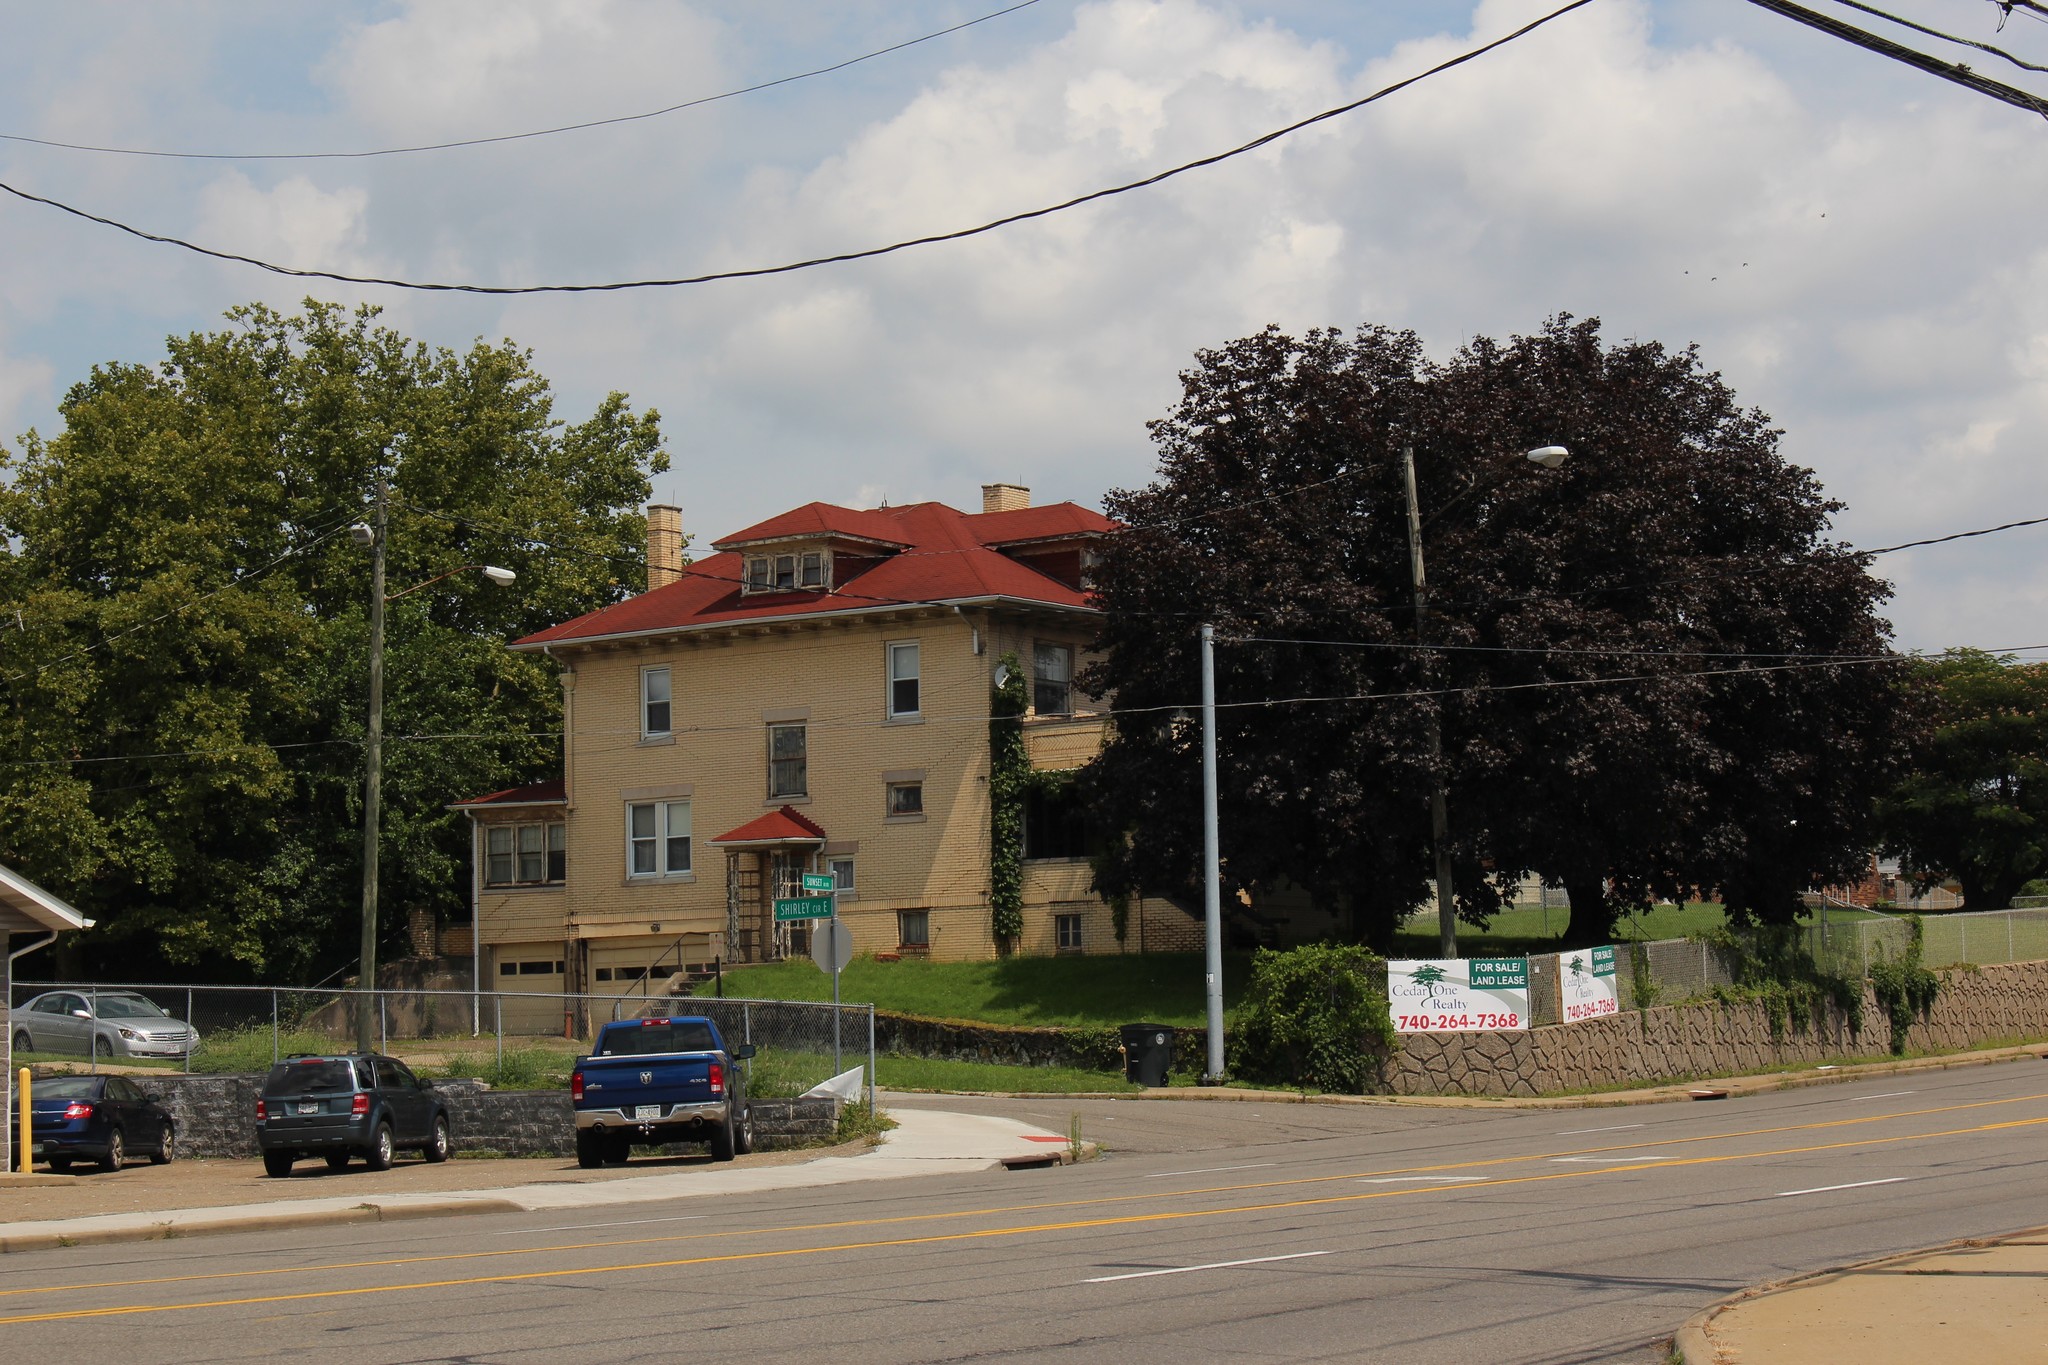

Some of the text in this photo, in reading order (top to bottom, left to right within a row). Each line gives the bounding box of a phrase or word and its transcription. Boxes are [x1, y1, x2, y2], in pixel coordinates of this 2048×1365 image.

[807, 878, 822, 887] SUNSET
[781, 901, 828, 915] SHIRLEY CIR E
[1475, 962, 1520, 972] FOR SALE/
[1593, 962, 1615, 974] LAND LEASE
[1471, 975, 1525, 985] LAND LEASE
[1563, 975, 1588, 988] Cedar One
[1392, 984, 1458, 997] Cedar One
[1433, 999, 1468, 1011] Realty
[1567, 998, 1616, 1020] 740-264-7368
[1399, 1013, 1519, 1029] 740-264-7368
